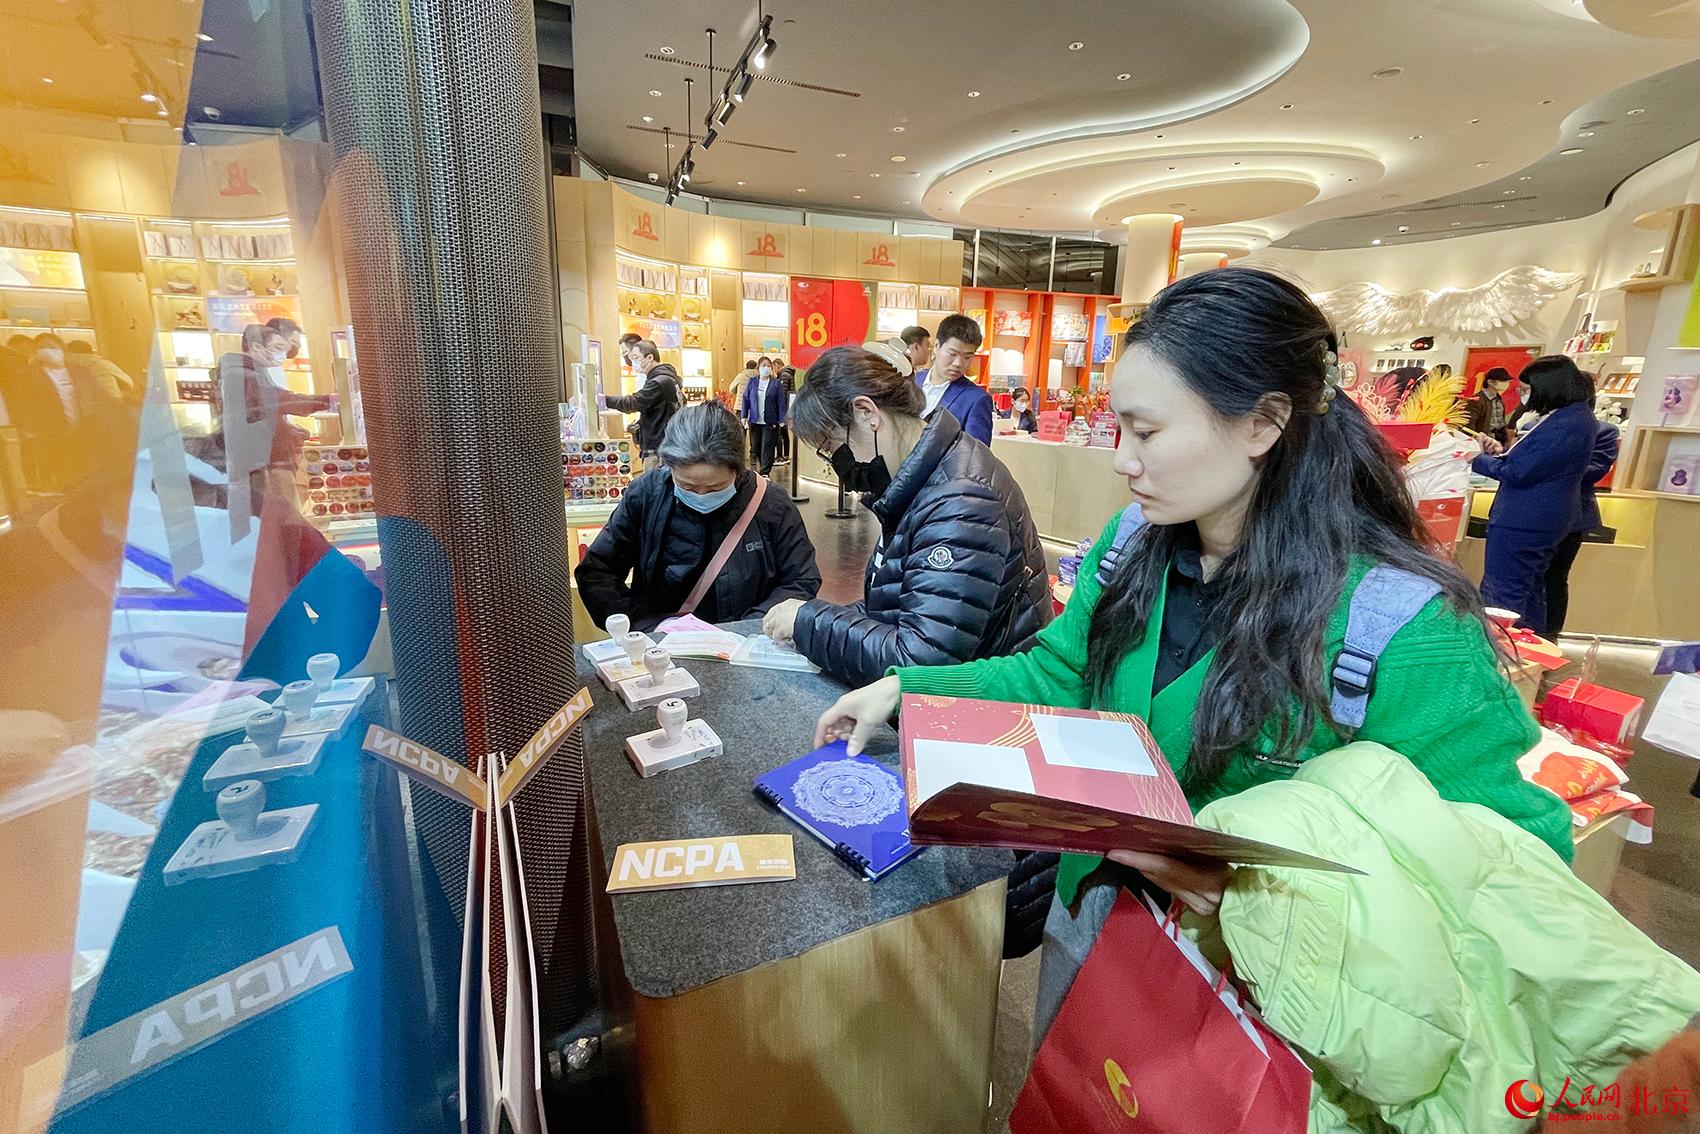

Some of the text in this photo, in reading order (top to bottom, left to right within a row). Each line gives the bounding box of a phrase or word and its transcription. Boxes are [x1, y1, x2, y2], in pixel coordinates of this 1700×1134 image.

[637, 211, 652, 234] 18
[756, 233, 777, 252] 18
[871, 243, 889, 262] 18
[795, 312, 828, 348] 18
[618, 842, 745, 882] NCPA
